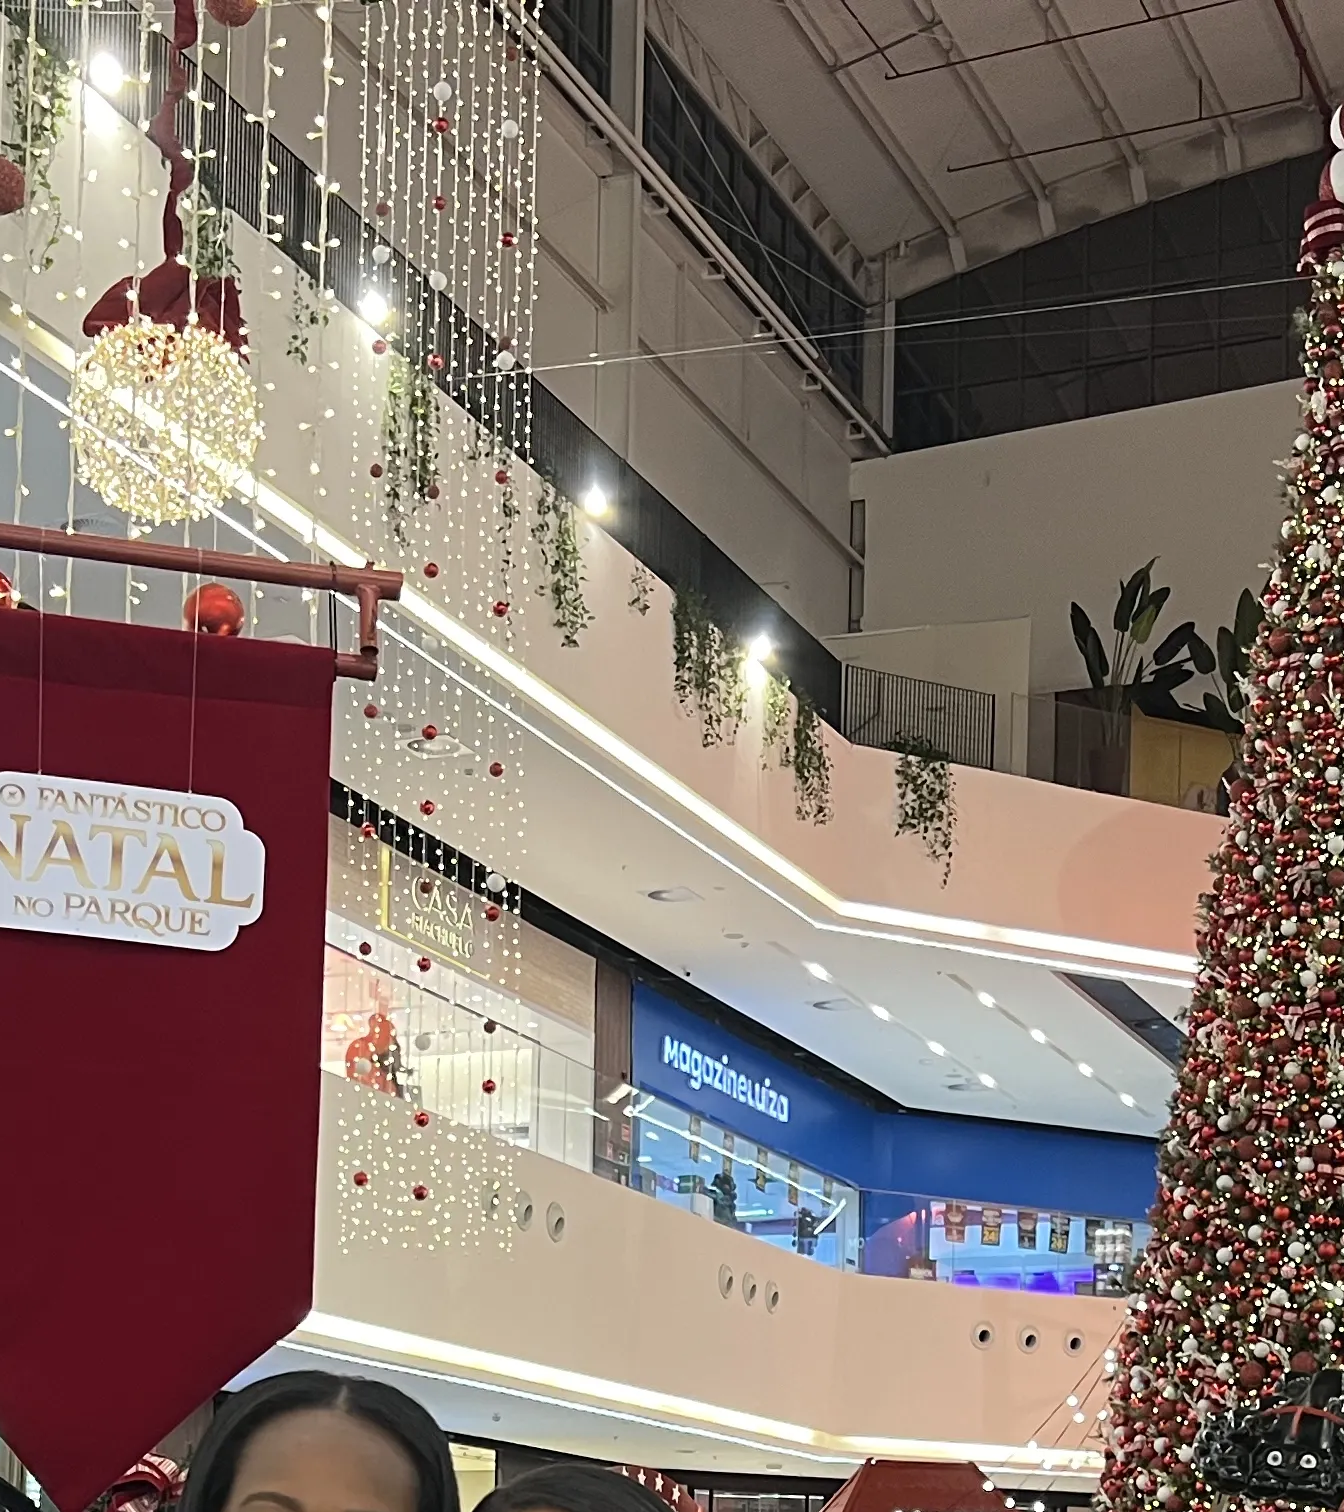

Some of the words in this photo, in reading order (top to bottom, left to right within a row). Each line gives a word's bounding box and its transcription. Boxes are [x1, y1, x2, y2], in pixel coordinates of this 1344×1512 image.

[37, 786, 226, 832] FANTÁSTICO
[13, 894, 54, 917] NO
[64, 892, 211, 936] PARQUE
